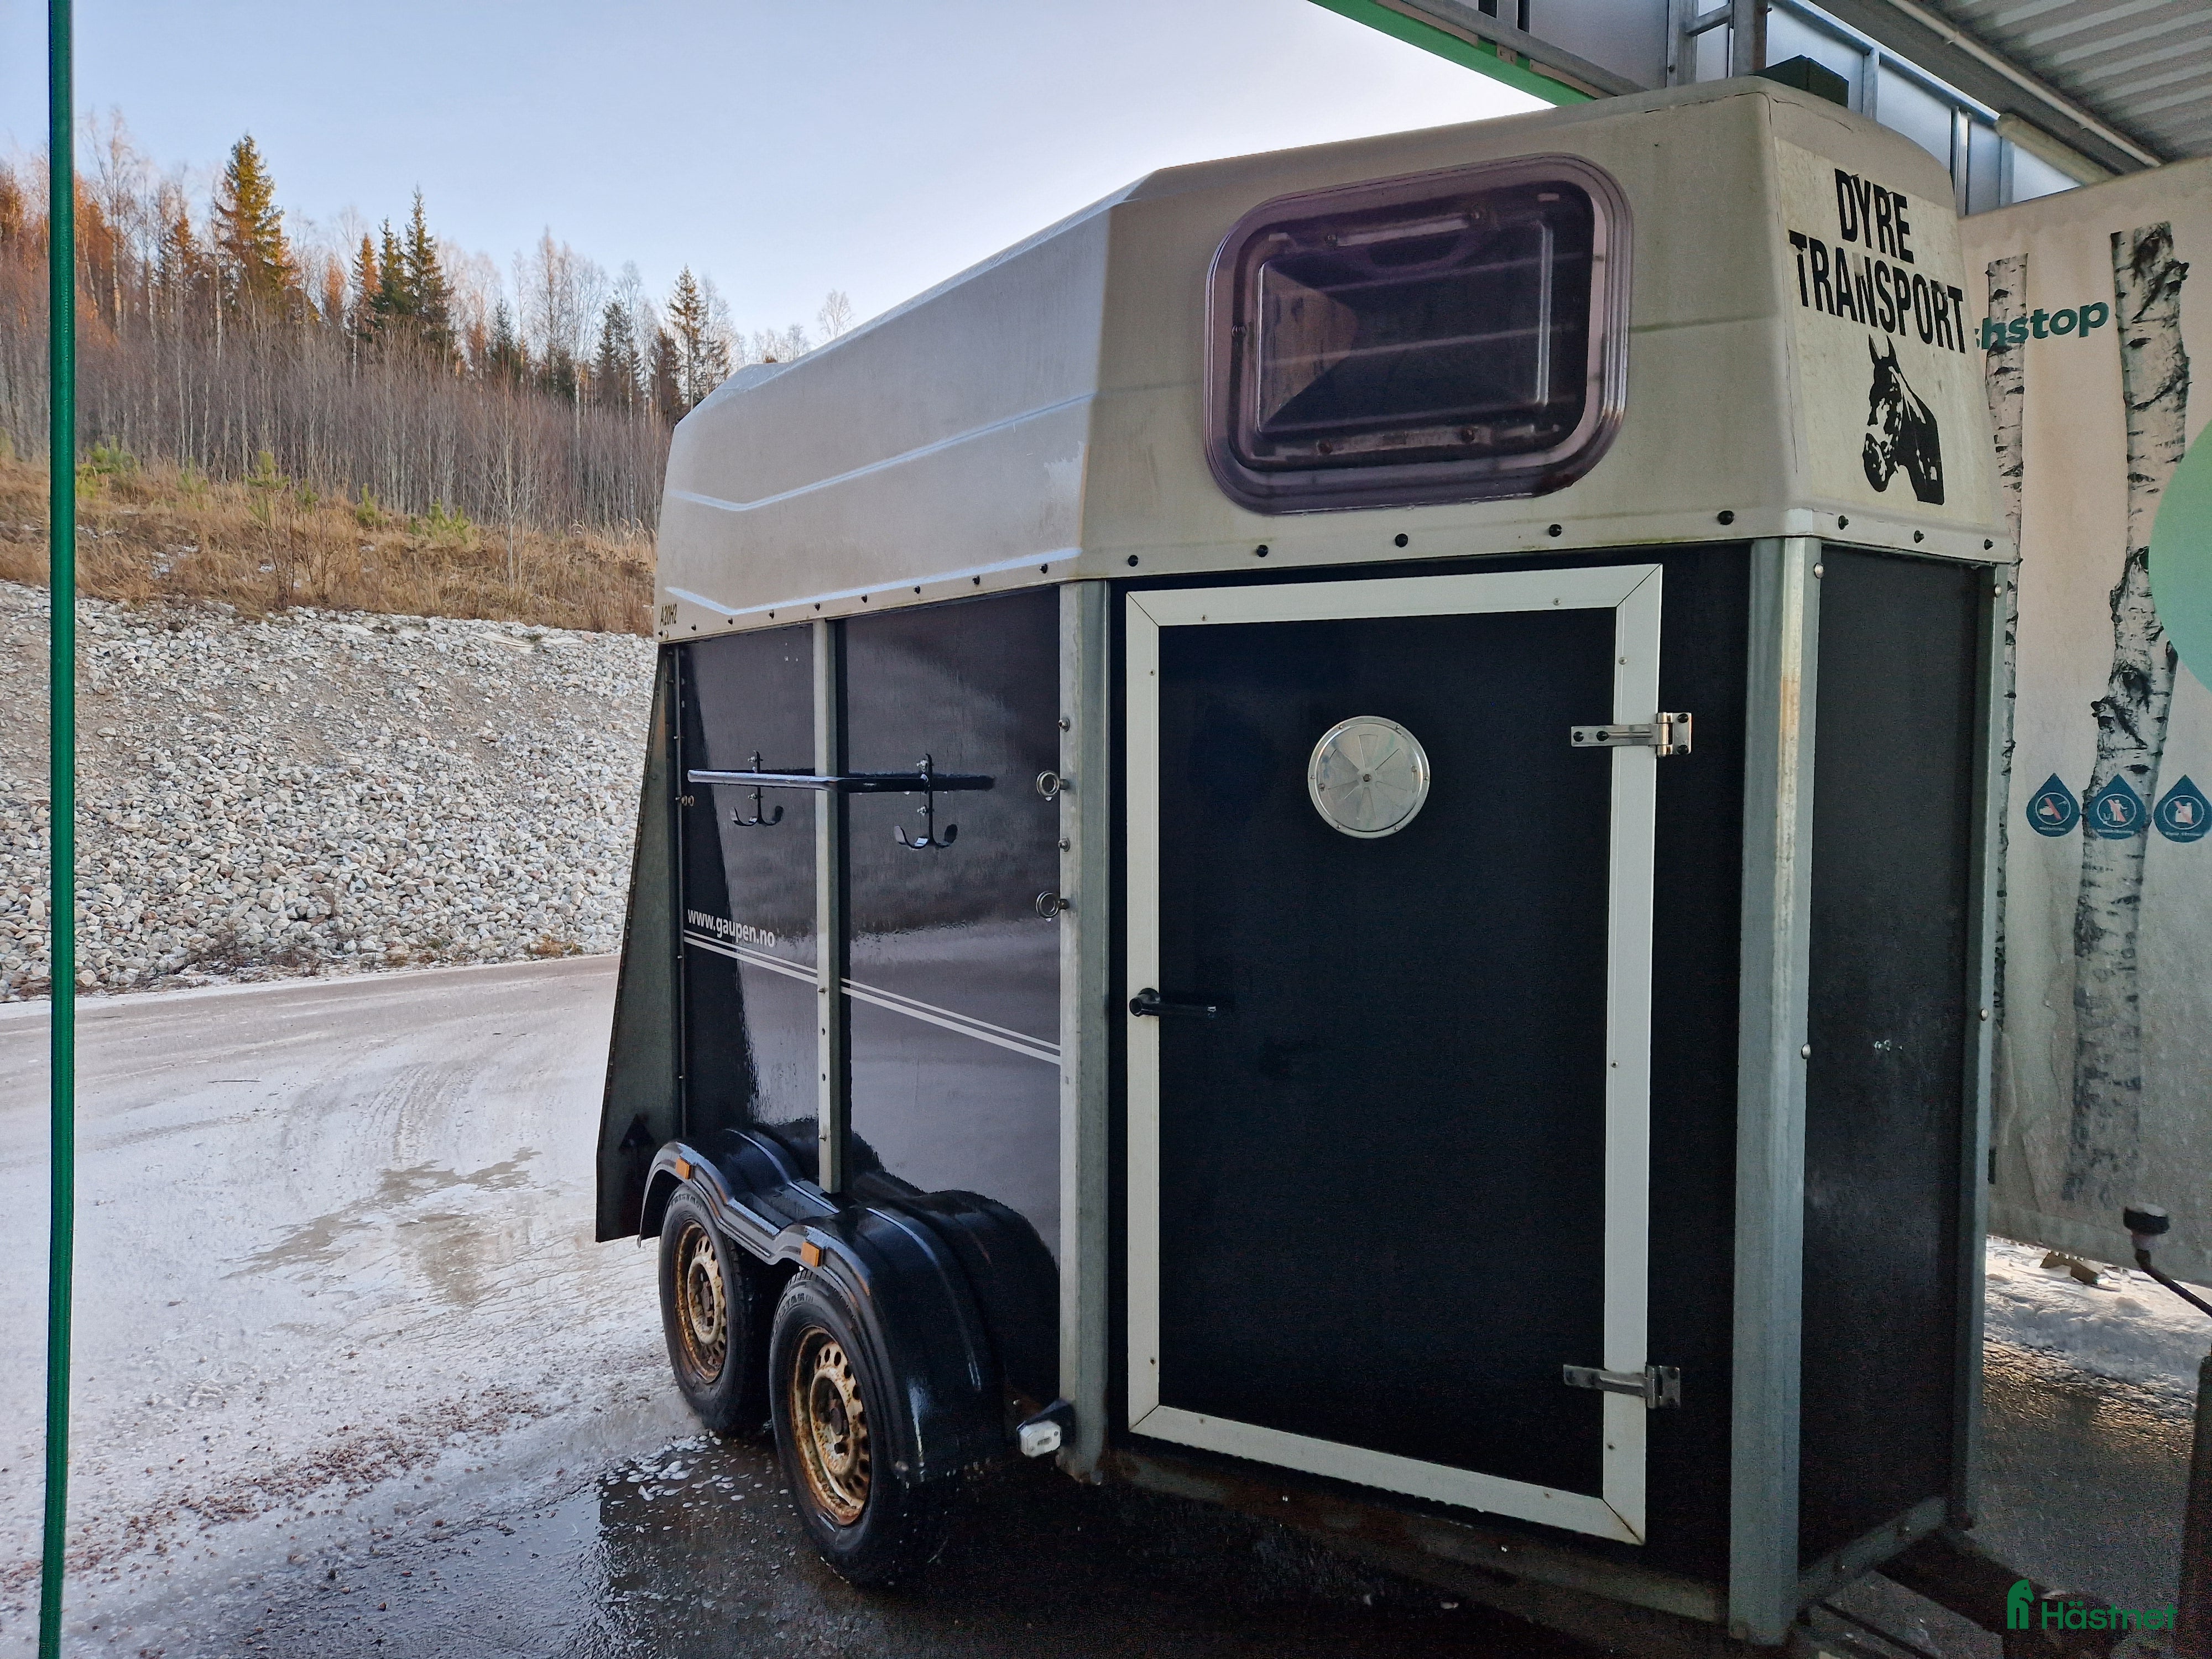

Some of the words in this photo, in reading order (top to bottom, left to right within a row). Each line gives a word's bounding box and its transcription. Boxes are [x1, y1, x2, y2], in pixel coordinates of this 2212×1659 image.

[1834, 168, 1914, 264] DYRE
[1788, 229, 1966, 353] TRANSPORT
[1975, 301, 2110, 349] hstop
[660, 603, 677, 627] A20H2
[687, 909, 775, 948] www.gaupen.no
